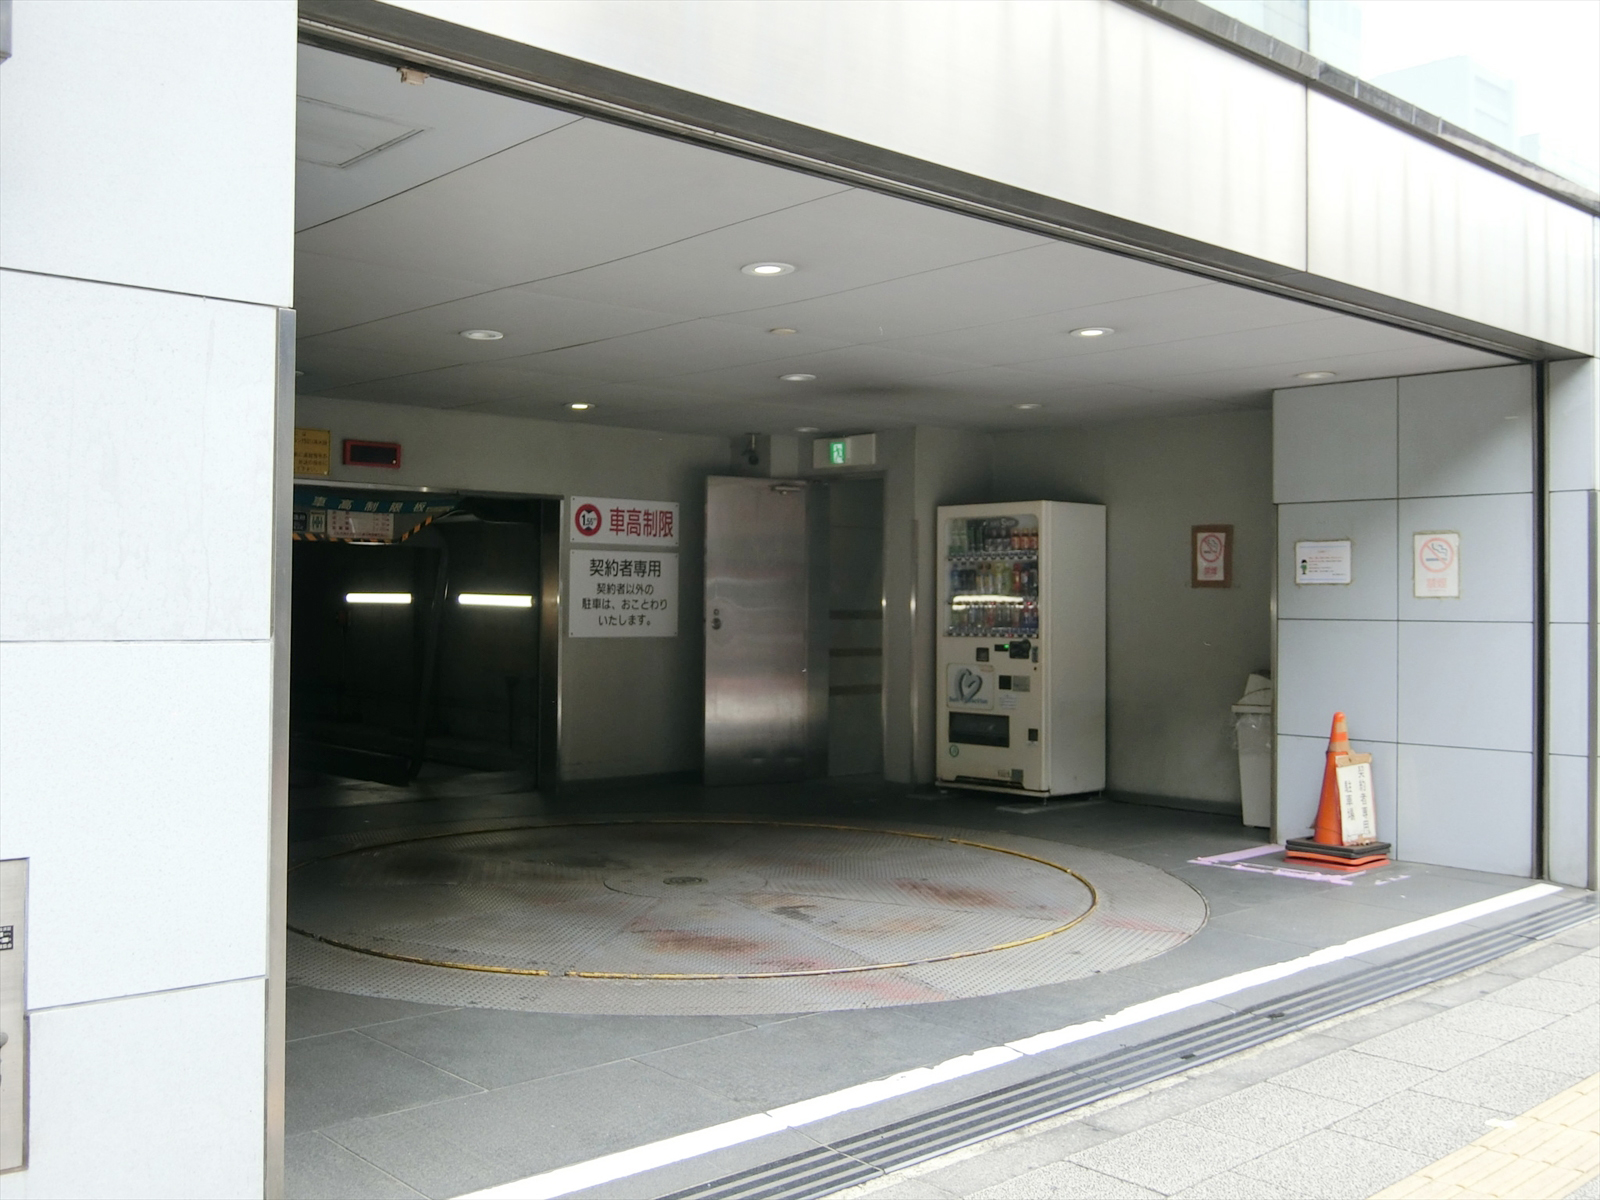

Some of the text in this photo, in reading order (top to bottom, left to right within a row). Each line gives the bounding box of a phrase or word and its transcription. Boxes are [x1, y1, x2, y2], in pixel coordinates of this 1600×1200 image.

[609, 507, 674, 538] 車高制限
[590, 558, 661, 578] 契約者専用
[597, 583, 654, 596] 契約者以外の
[582, 598, 668, 611] 駐車は、おことわり
[598, 614, 651, 627] いたします。
